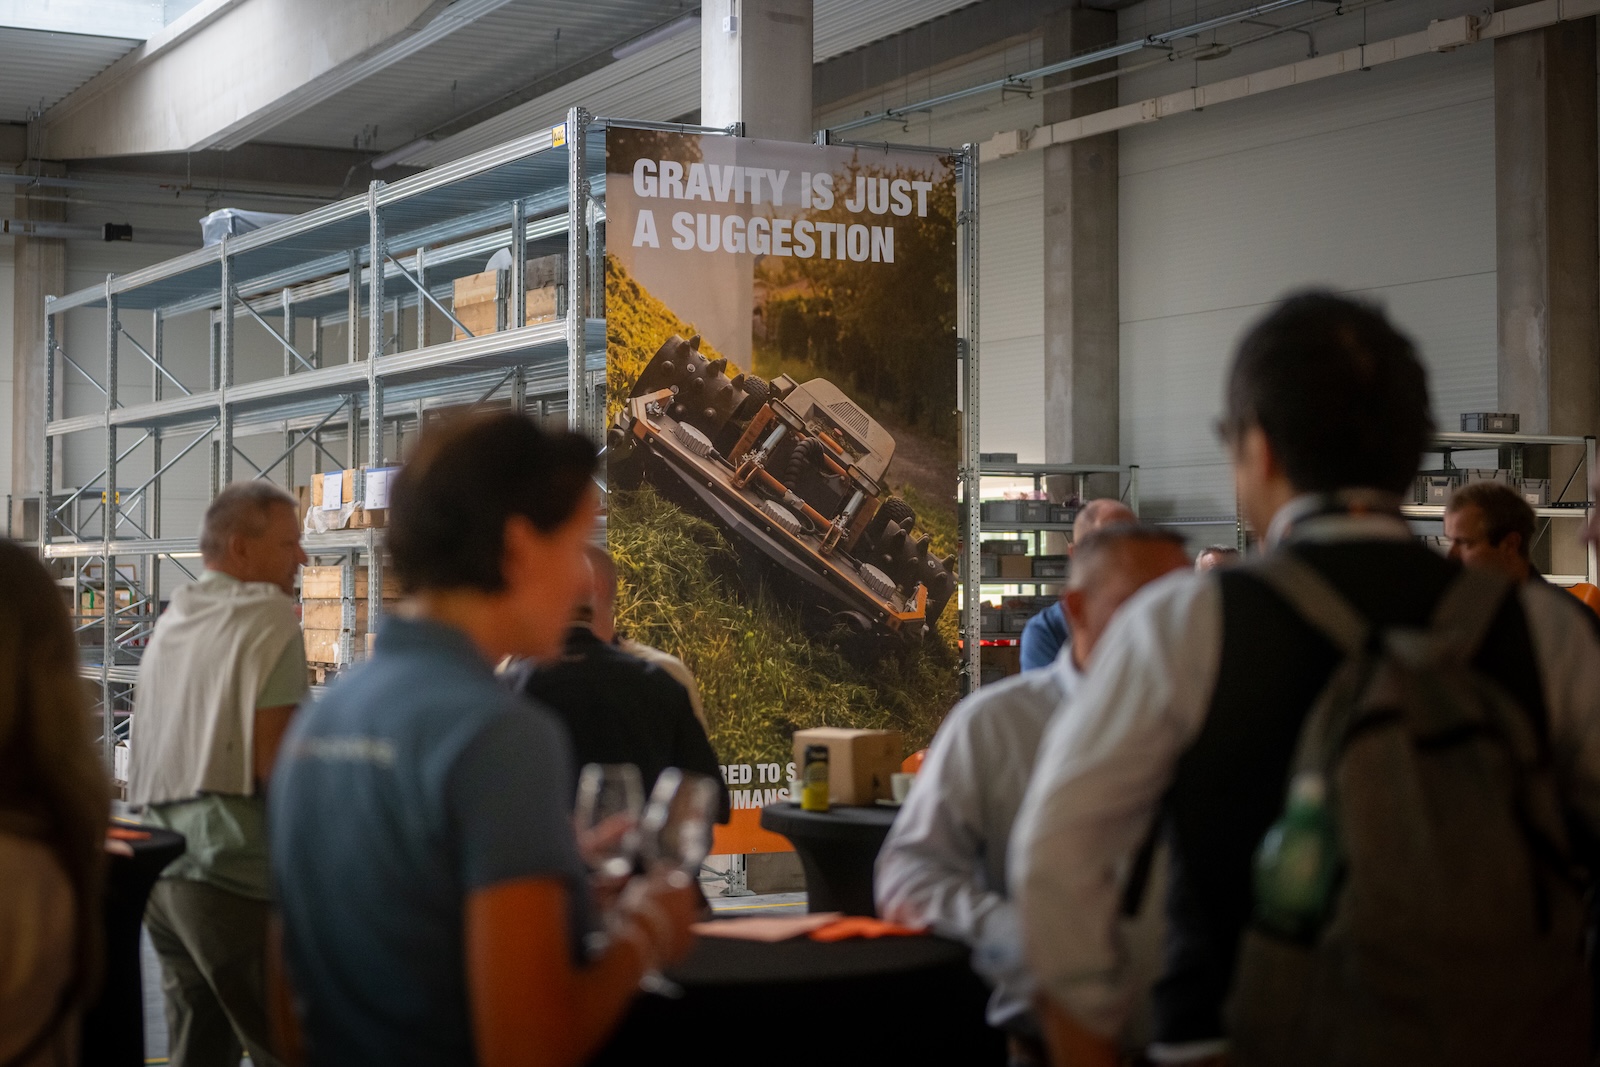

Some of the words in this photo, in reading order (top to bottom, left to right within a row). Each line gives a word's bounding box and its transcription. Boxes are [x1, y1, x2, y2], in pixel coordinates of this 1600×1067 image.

[632, 158, 790, 207] GRAVITY
[801, 172, 834, 211] IS
[845, 176, 933, 218] JUST
[632, 209, 660, 249] A
[671, 211, 895, 264] SUGGESTION
[719, 764, 752, 785] RED
[756, 762, 781, 784] TO
[785, 762, 797, 783] S
[729, 788, 790, 810] MANS
